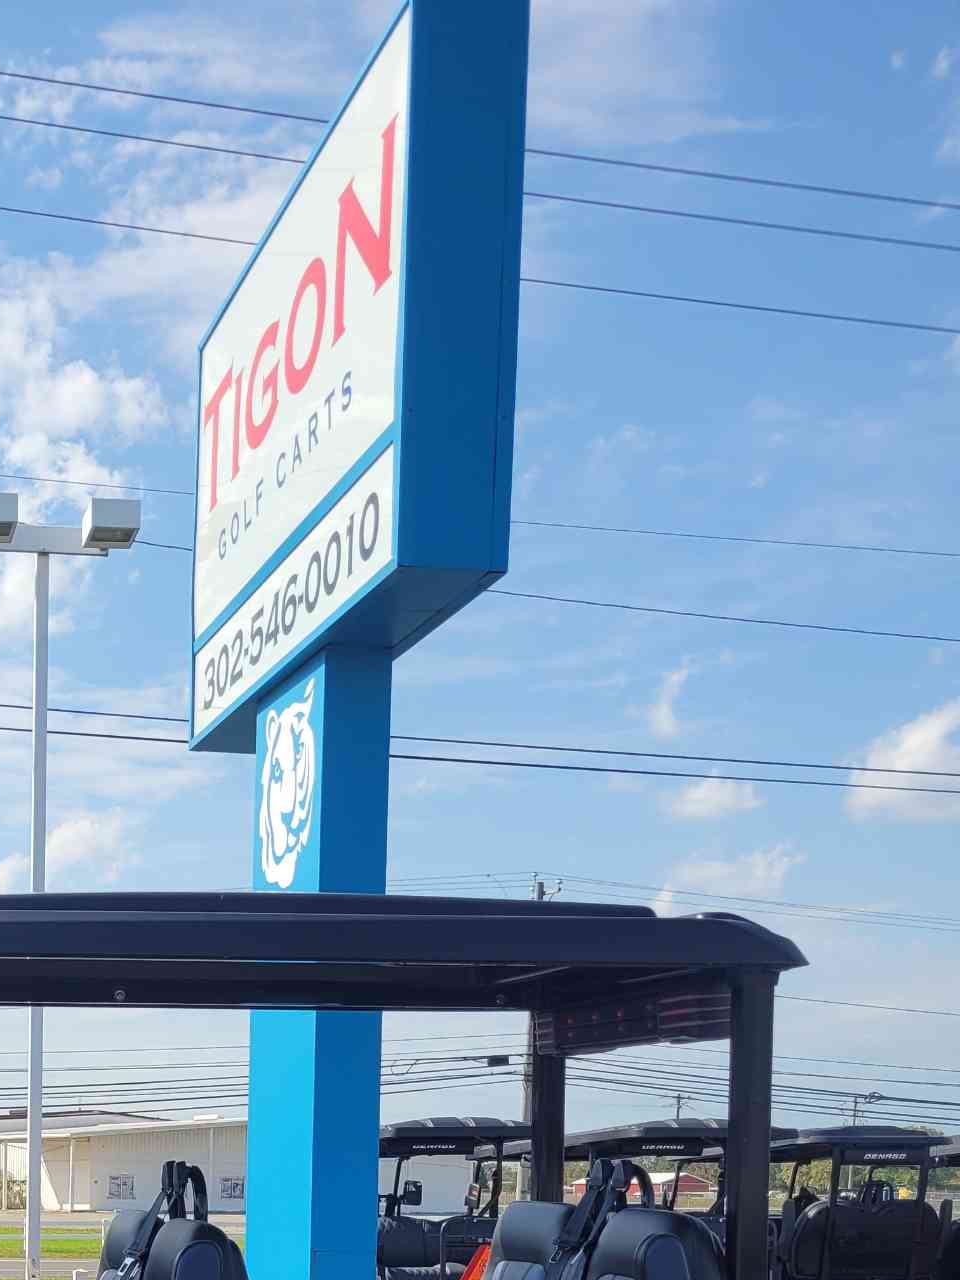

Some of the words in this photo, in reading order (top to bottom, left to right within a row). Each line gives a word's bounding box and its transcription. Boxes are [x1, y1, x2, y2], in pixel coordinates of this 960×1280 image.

[204, 111, 399, 513] TIGON
[218, 476, 264, 561] GOLF
[276, 369, 353, 489] CARTS
[203, 491, 380, 710] 302-546-0010
